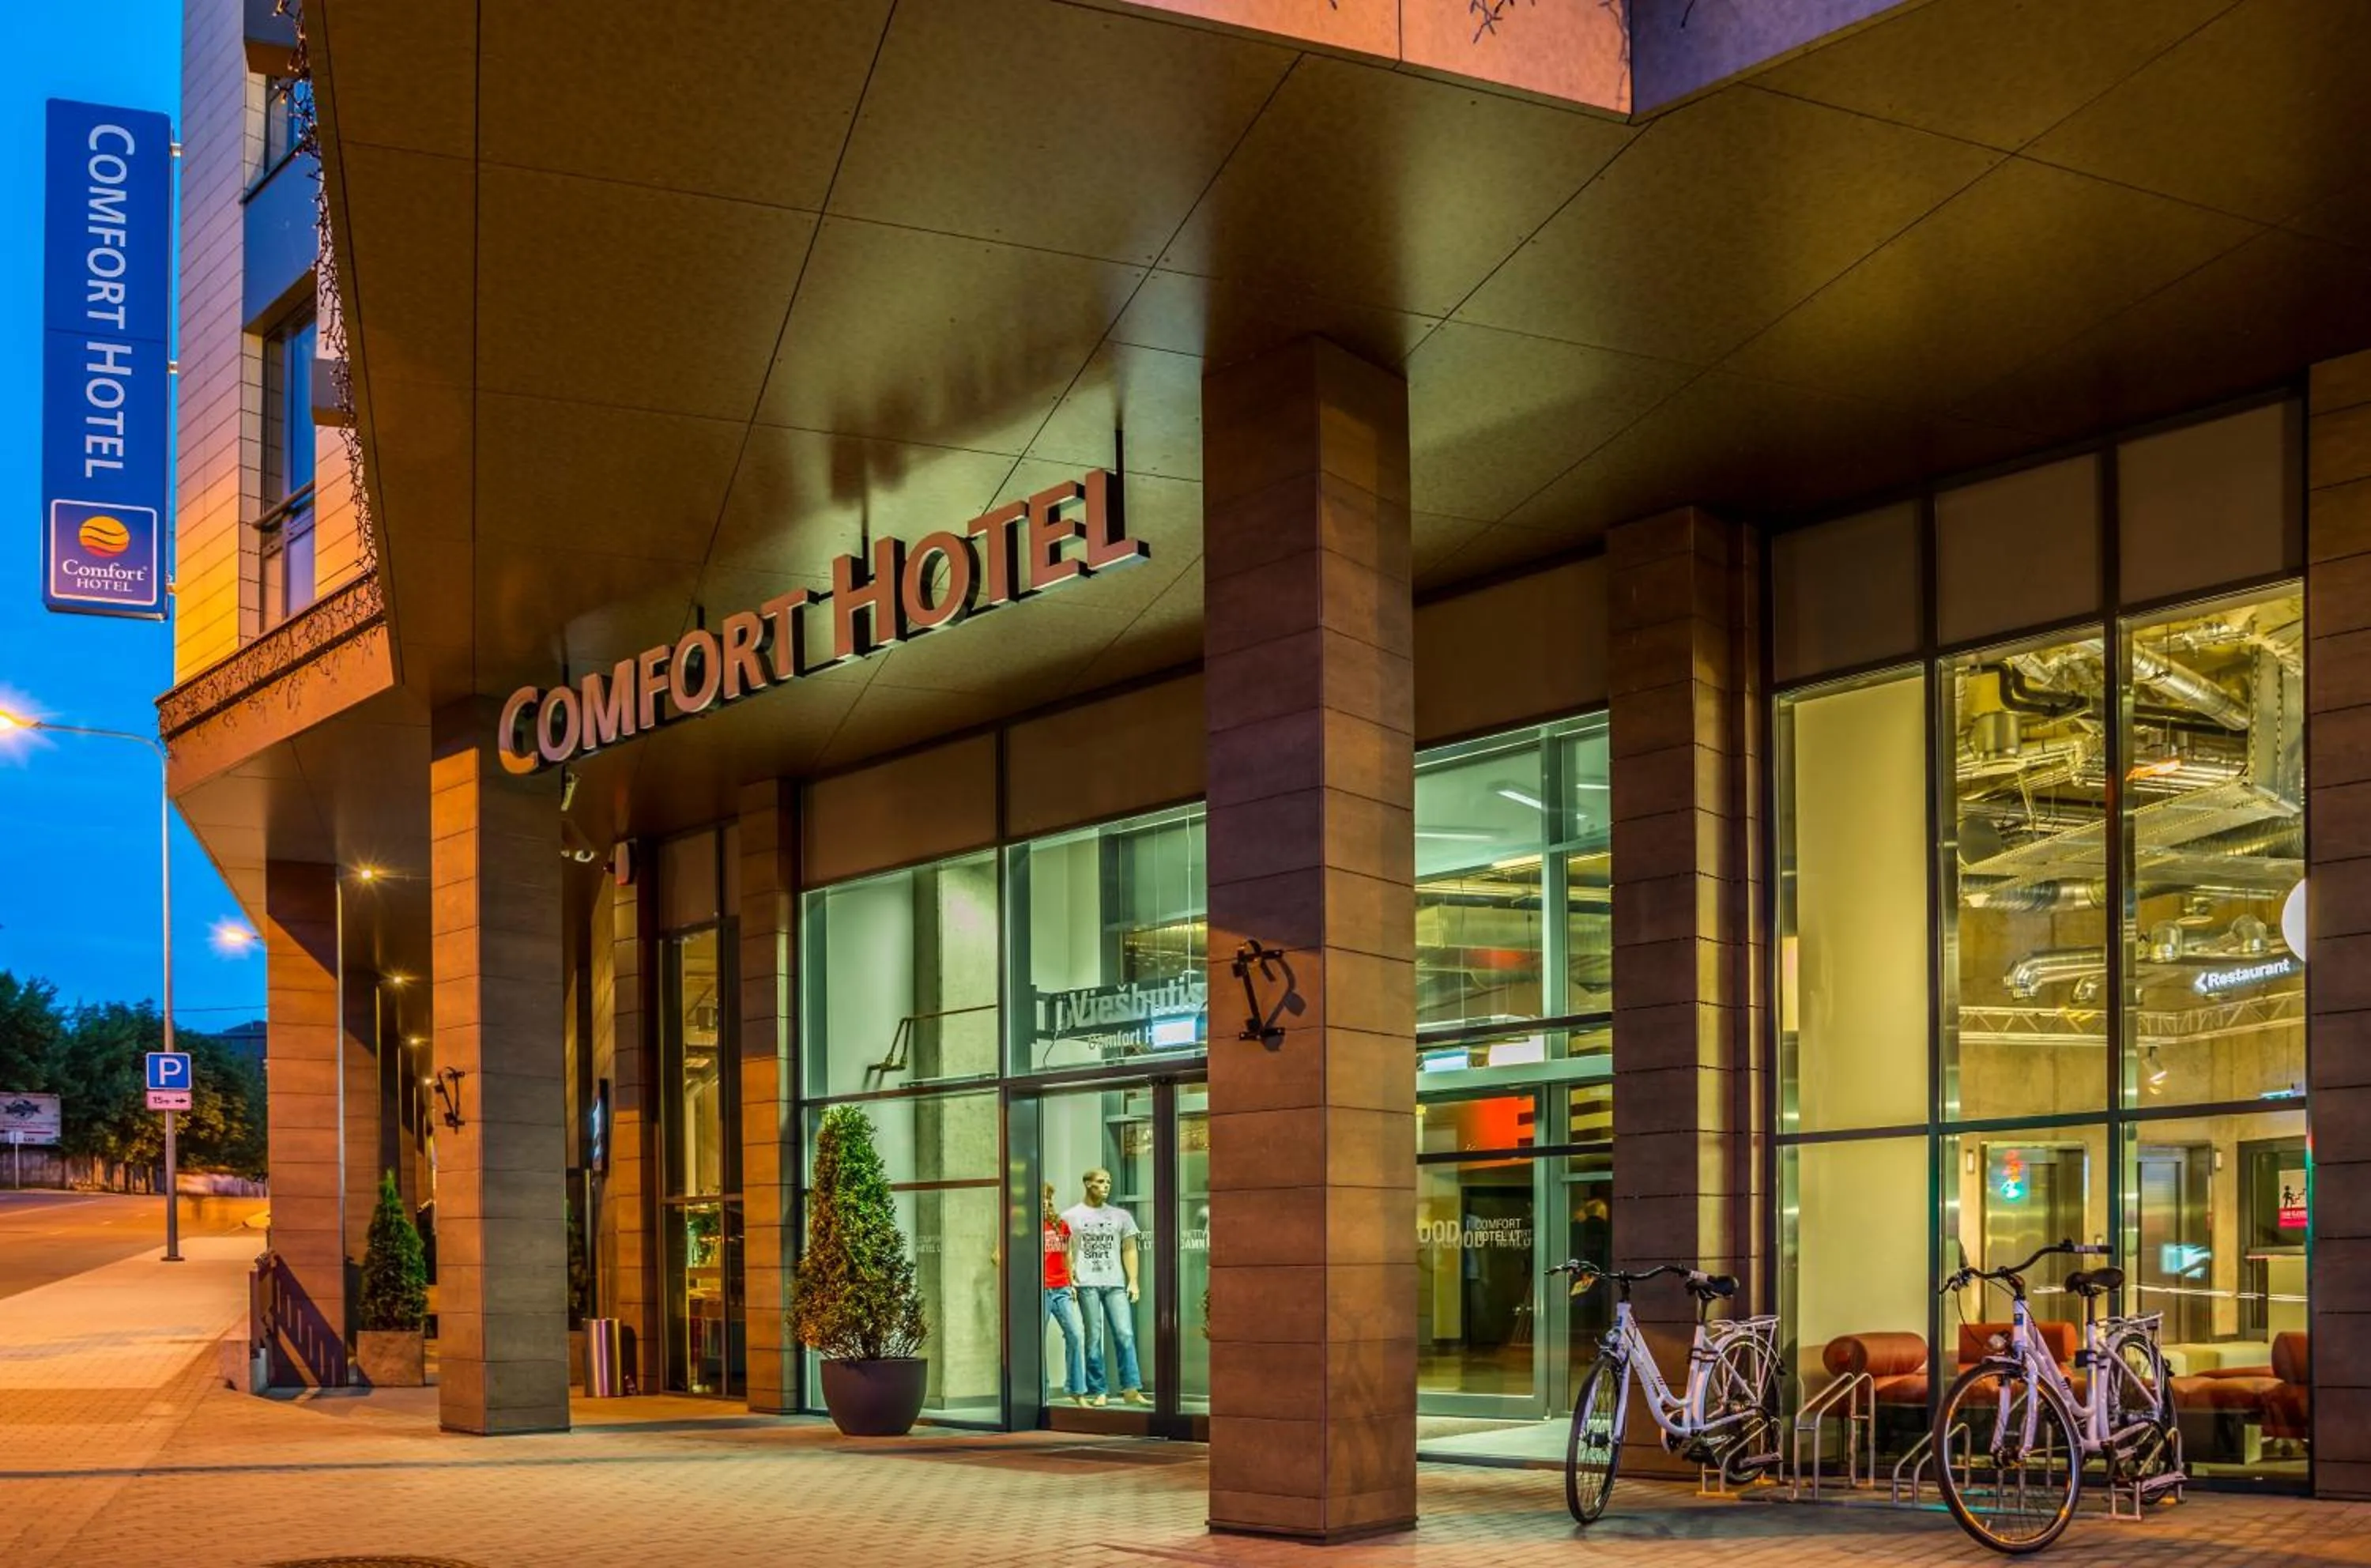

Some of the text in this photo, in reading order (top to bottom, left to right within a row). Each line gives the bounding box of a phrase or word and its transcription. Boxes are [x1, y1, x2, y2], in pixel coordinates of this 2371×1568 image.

[85, 123, 135, 478] COMFORT HOTEL
[62, 559, 145, 581] Comfort
[77, 577, 133, 592] HOTEL
[498, 467, 1149, 775] COMFORT HOTEL
[2207, 957, 2290, 988] Restaurant
[159, 1057, 183, 1085] P
[1476, 1218, 1522, 1231] COMFORT
